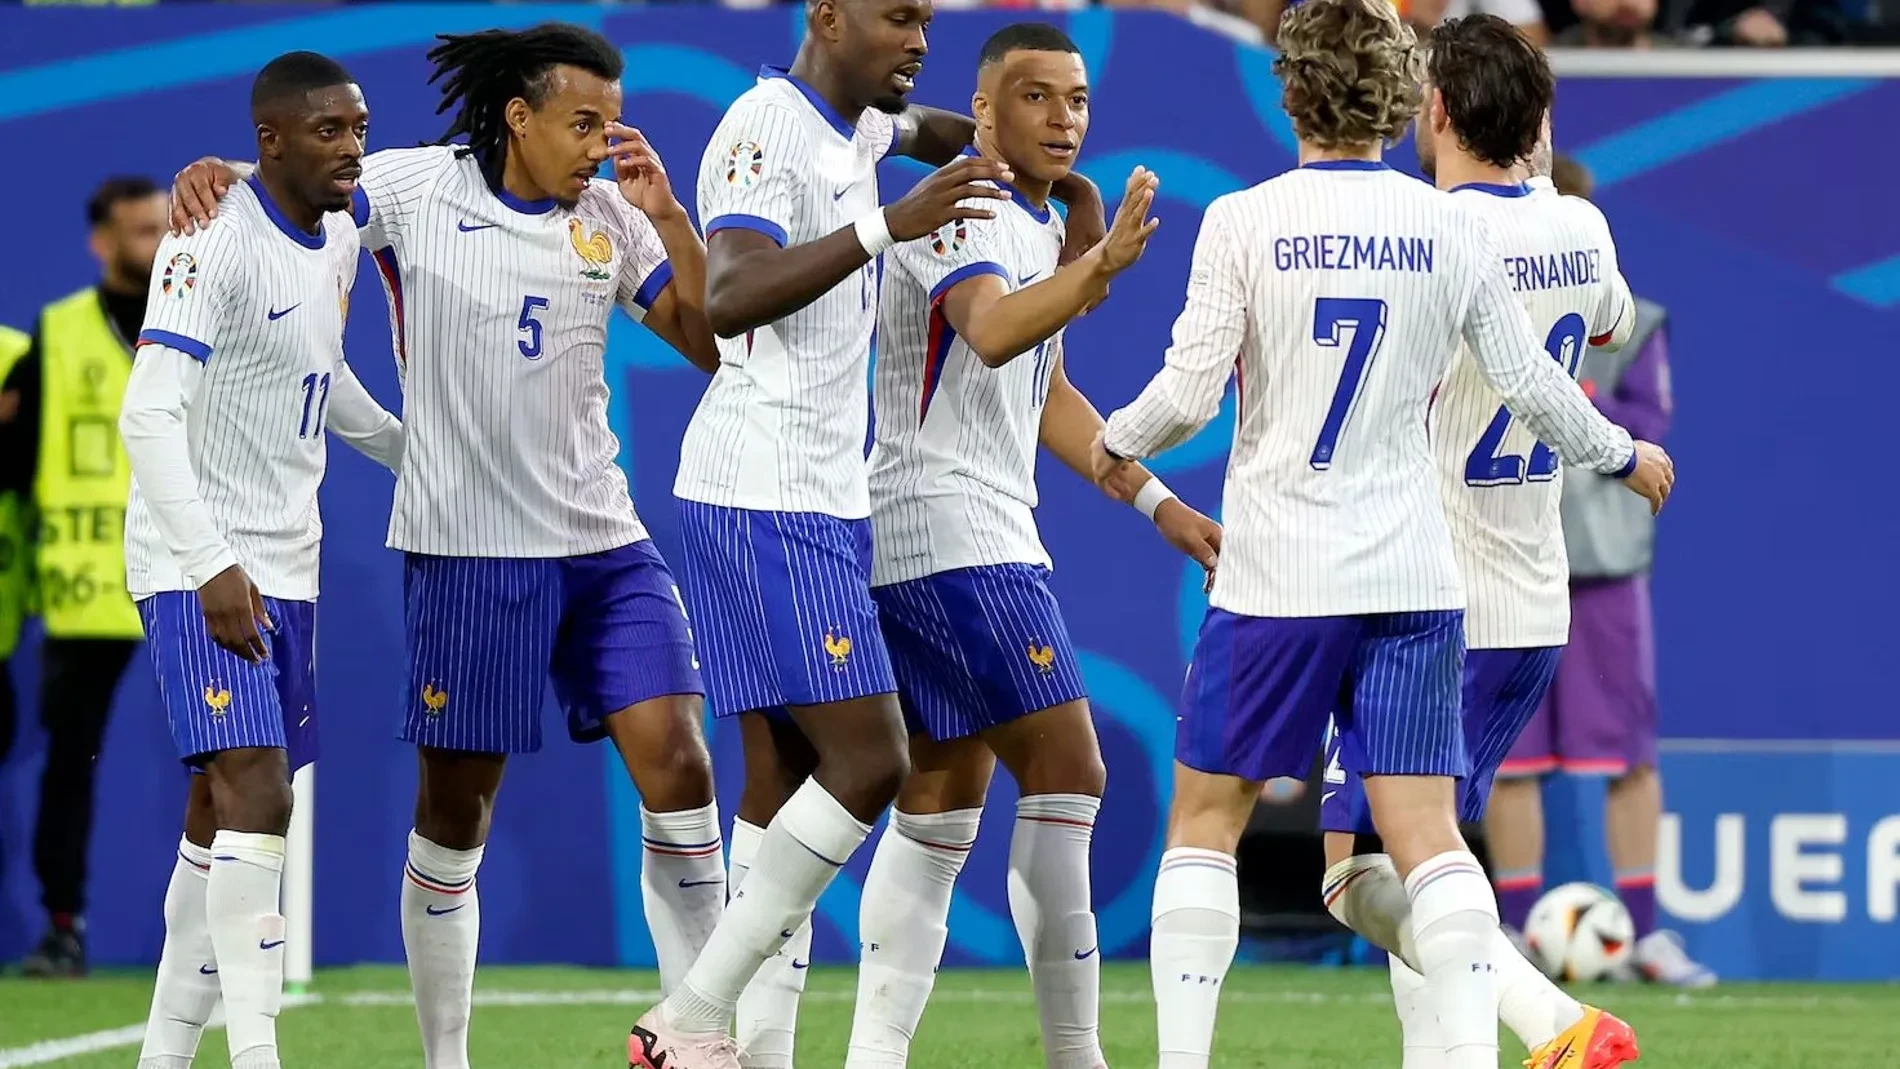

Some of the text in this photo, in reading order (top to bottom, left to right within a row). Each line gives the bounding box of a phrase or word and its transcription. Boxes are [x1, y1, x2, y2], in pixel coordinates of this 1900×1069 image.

[1274, 235, 1434, 273] GRIEZMANN
[517, 295, 549, 361] 5
[299, 373, 331, 440] 11
[1310, 297, 1388, 471] 7
